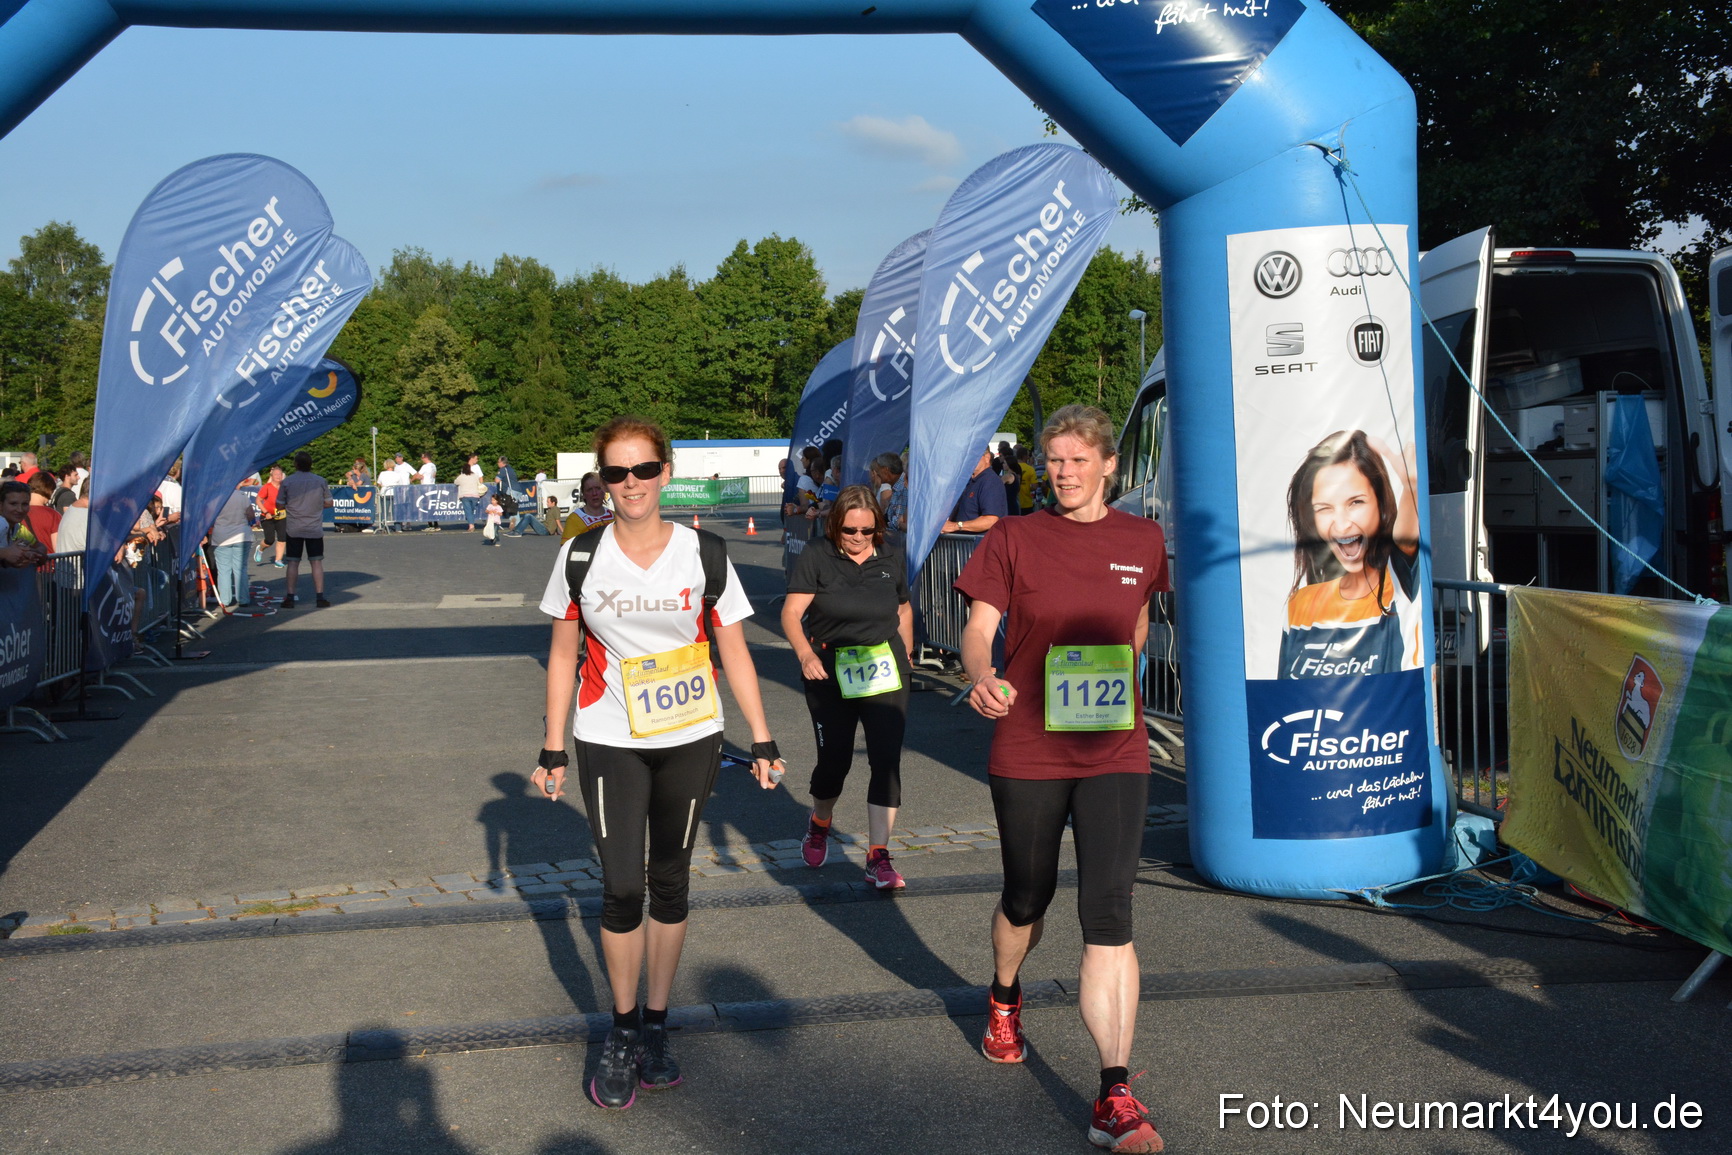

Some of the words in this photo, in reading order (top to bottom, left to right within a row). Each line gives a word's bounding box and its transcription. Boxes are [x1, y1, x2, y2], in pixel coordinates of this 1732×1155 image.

[1223, 0, 1270, 17] mit!
[159, 195, 284, 358] Fischer
[965, 179, 1073, 346] Fischer
[1007, 209, 1087, 342] AUTOMOBILE
[201, 228, 298, 358] AUTOMOBILE
[1330, 284, 1362, 296] Audi
[235, 259, 332, 387] Fischer
[270, 282, 343, 385] AUTOMOBILE
[1357, 330, 1382, 353] FIAT
[1254, 361, 1319, 376] SEAT
[283, 418, 308, 436] Druck
[323, 393, 352, 415] Medien
[1110, 563, 1143, 573] Firmenlauf
[1121, 577, 1137, 585] 2016
[594, 587, 692, 618] Xplus1
[843, 660, 891, 684] 1123
[1300, 654, 1378, 676] Fischer
[637, 675, 705, 714] 1609
[1056, 679, 1126, 707] 1122
[1289, 728, 1409, 757] Fischer
[1620, 728, 1636, 754] 1628
[1302, 753, 1403, 771] AUTOMOBILE
[1326, 783, 1354, 799] und
[1357, 779, 1381, 793] das
[1382, 771, 1425, 790] Lächeln
[1362, 793, 1396, 815] fährt
[1398, 784, 1422, 801] mit!
